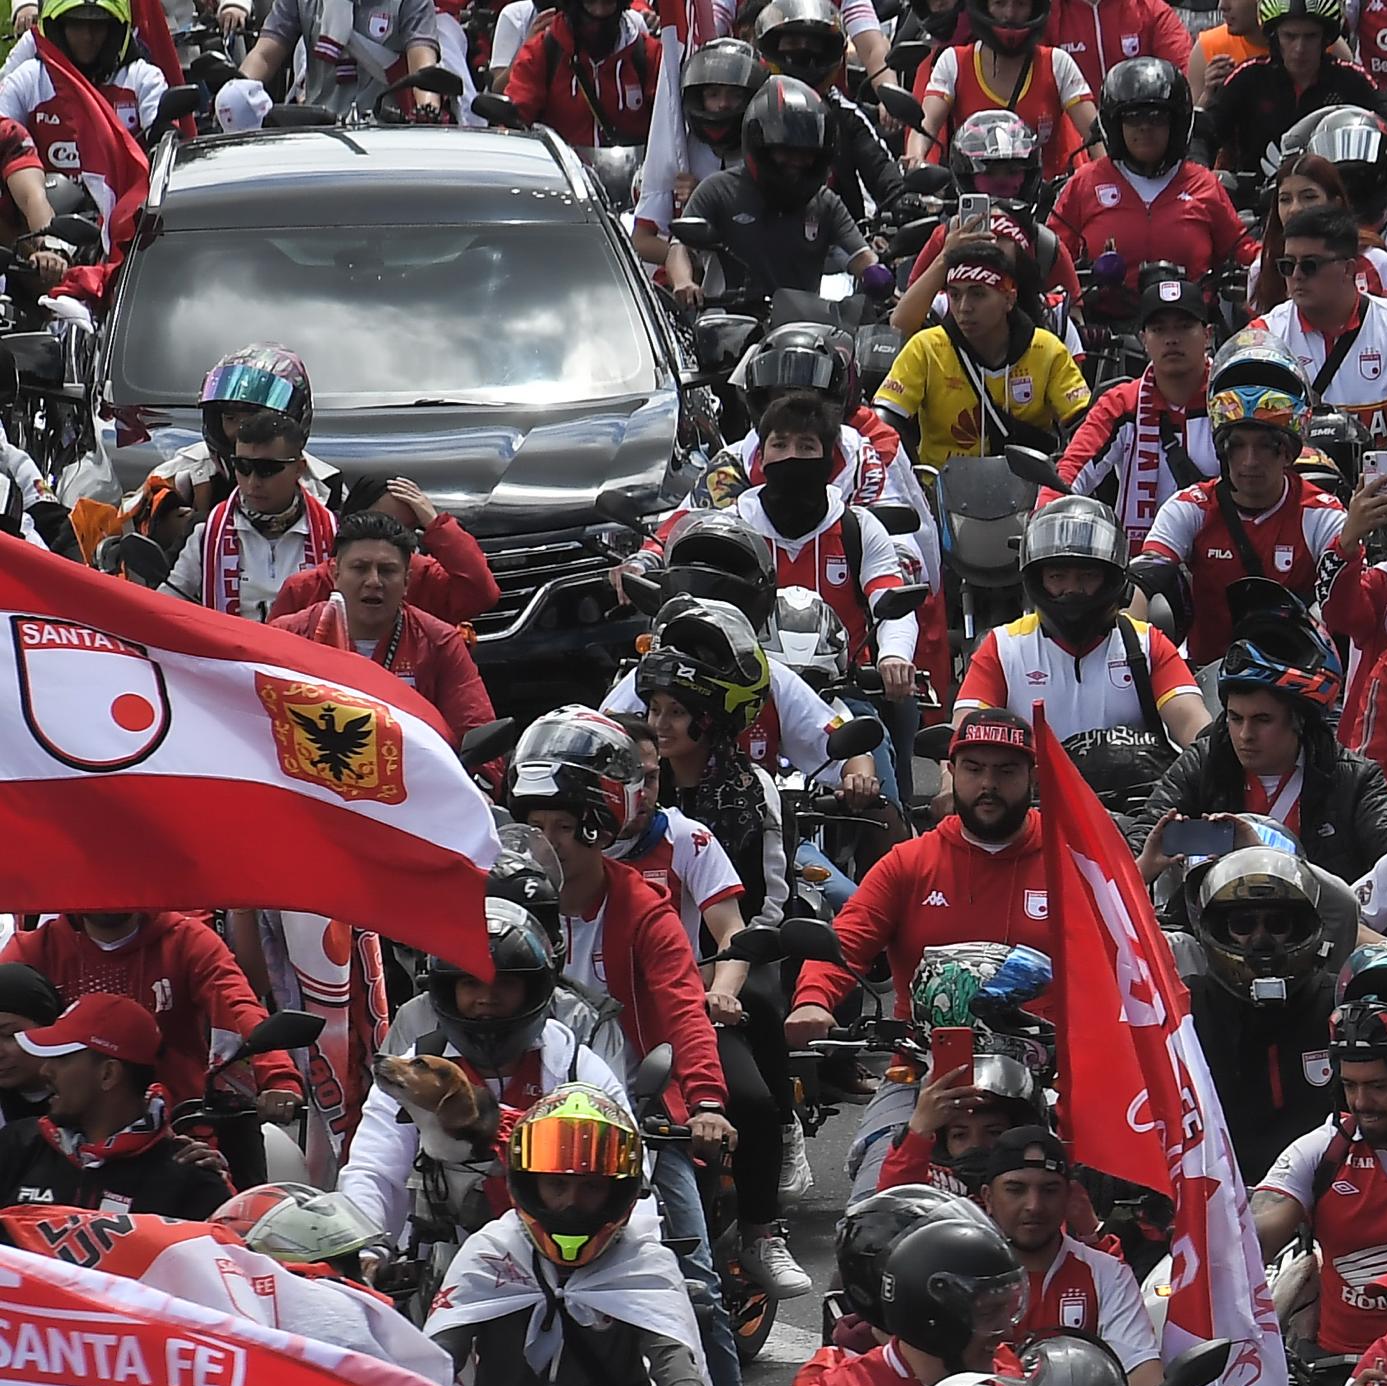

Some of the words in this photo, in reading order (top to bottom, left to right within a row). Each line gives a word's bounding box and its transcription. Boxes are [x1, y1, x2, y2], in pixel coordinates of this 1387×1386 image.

[1207, 547, 1233, 560] FILA
[22, 622, 113, 652] SANTA
[965, 724, 1009, 742] SANTA
[1011, 729, 1025, 745] FE
[19, 1188, 54, 1203] FILA
